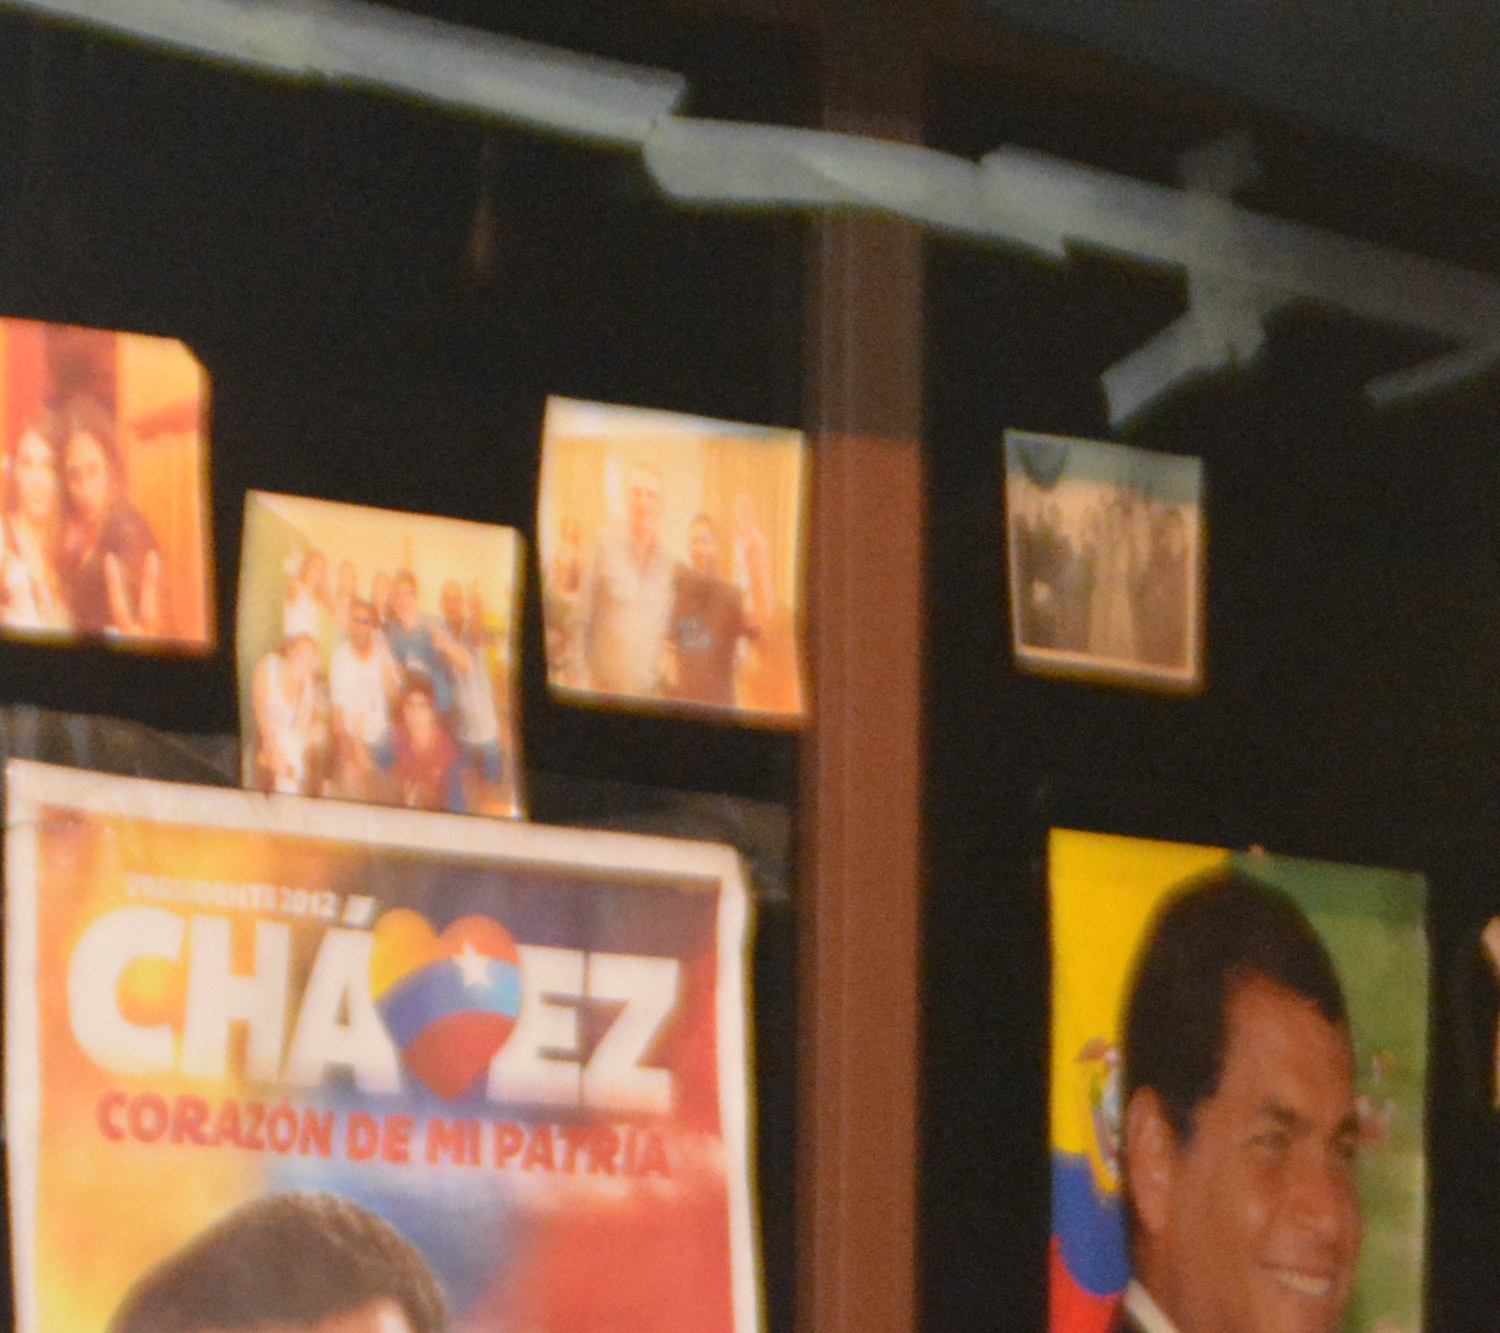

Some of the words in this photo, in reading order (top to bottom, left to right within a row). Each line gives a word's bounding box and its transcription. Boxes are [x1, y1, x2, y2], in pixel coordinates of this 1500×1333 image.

[97, 1090, 336, 1158] CORAZÓN
[345, 1111, 416, 1164] DE
[424, 1115, 483, 1168] MI
[498, 1118, 673, 1180] PATRIA
